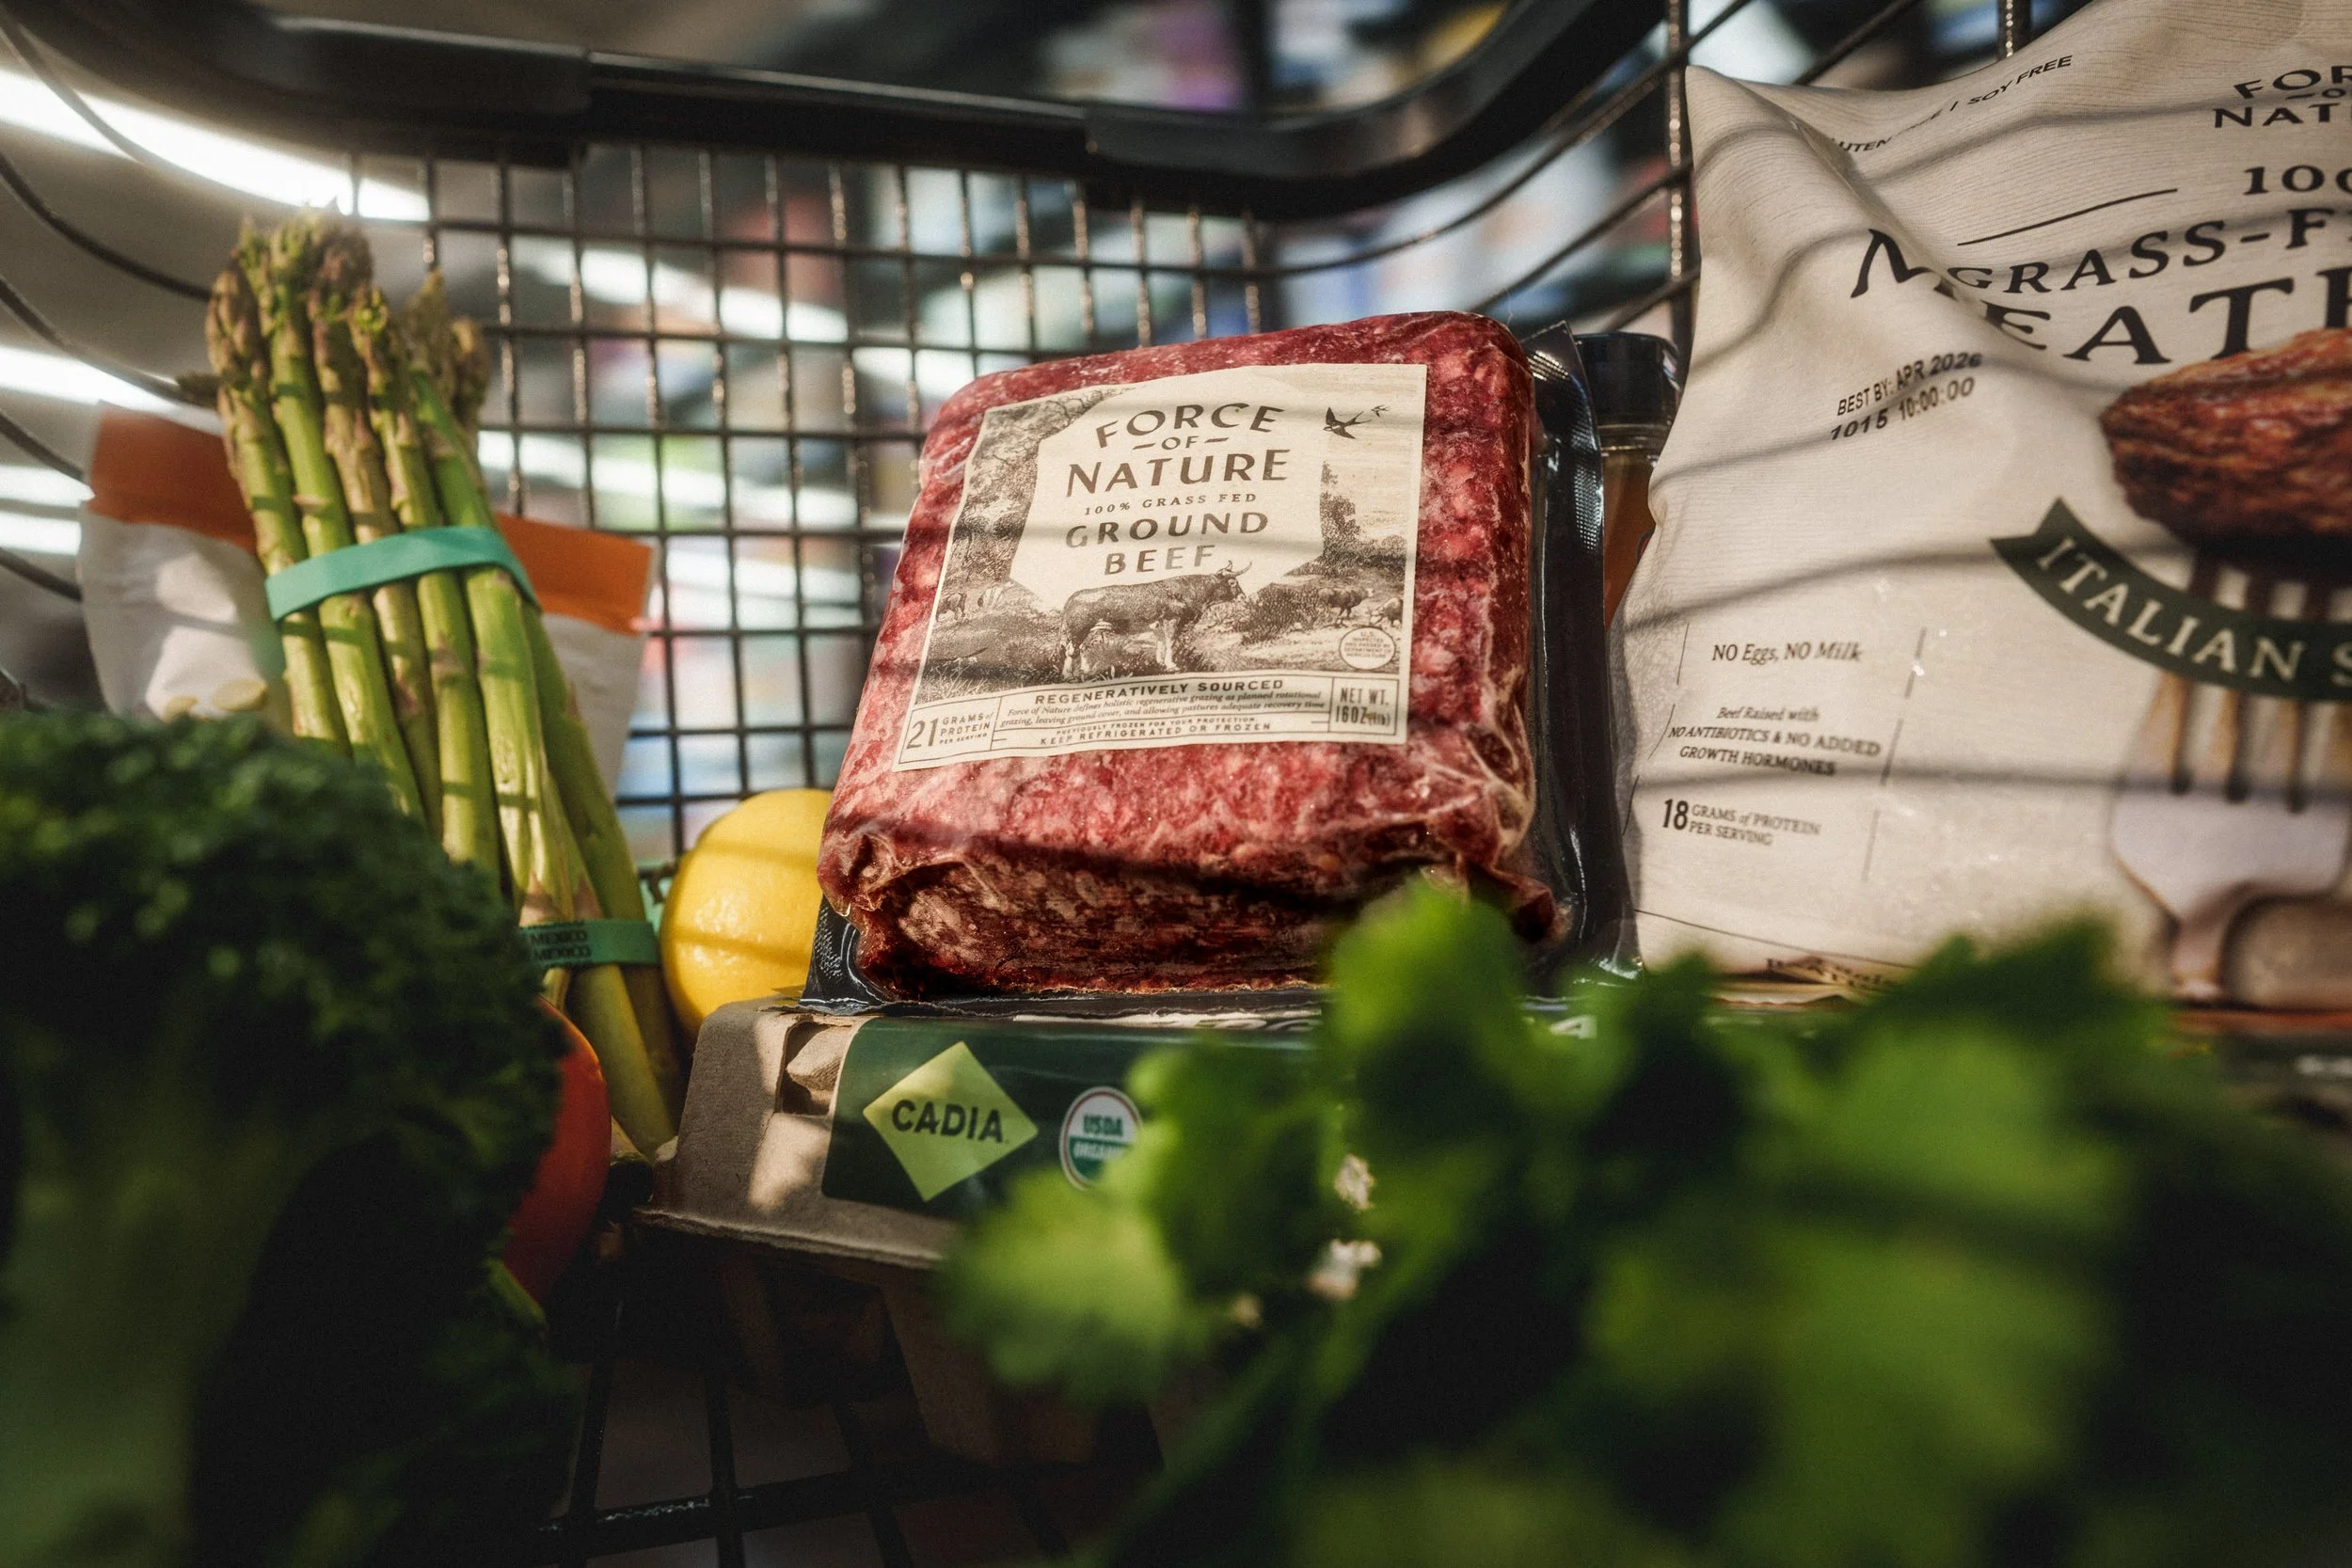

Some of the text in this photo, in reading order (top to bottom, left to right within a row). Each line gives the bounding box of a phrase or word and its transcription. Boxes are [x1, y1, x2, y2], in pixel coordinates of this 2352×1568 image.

[1966, 81, 2012, 105] SOY
[2015, 55, 2074, 85] FREE
[2213, 103, 2352, 128] NAT
[1947, 206, 2352, 294] GRASS-F
[1837, 352, 1983, 416] BEST BY: APR 2026
[1830, 376, 1976, 440] 1015 10:00:00
[1096, 403, 1284, 448] FORCE
[1161, 436, 1199, 451] OF
[1066, 449, 1291, 498] NATURE
[1085, 493, 1257, 515] 100% GRASS FED
[1066, 512, 1268, 548] GROUND
[1104, 545, 1216, 576] BEEF
[2037, 538, 2304, 682] ITALIAN
[1712, 641, 1863, 666] NO Eggs, NO Milk
[1008, 708, 1030, 717] Force
[1031, 706, 1040, 716] of
[1041, 705, 1071, 715] Nature
[1073, 702, 1102, 713] defines
[1104, 699, 1134, 708] holistic
[1136, 695, 1188, 707] regenerative
[1189, 693, 1223, 704] grazing
[1237, 691, 1275, 702] planned
[1276, 690, 1322, 700] rotational
[1035, 680, 1284, 705] REGENERATIVELY SOURCED
[1340, 688, 1390, 705] NET WT.
[941, 721, 991, 736] PROTEIN
[1000, 718, 1033, 728] grazing,
[1035, 716, 1066, 725] leaving
[1067, 712, 1096, 723] ground
[1143, 705, 1180, 716] allowing
[1182, 705, 1218, 714] pastures
[1220, 701, 1262, 712] adequate
[1263, 701, 1303, 710] recovery
[1304, 700, 1326, 708] time
[1716, 706, 1820, 722] Beef Raised with
[906, 718, 939, 750] 21
[942, 713, 984, 725] GRAMS
[1041, 735, 1073, 745] KEEP
[1079, 727, 1182, 741] REFRIGERATED
[1216, 722, 1270, 732] FROZEN
[1668, 726, 1687, 738] NO
[1687, 726, 1771, 743] ANTIBIOTICS
[1786, 732, 1811, 748] NO
[1813, 735, 1881, 757] ADDED
[1679, 745, 1836, 777] GROWTH HORMONES
[1662, 799, 1689, 831] 18
[1692, 803, 1737, 822] GRAMS
[1753, 813, 1823, 836] PROTEIN
[1689, 820, 1774, 847] PER SERVING
[891, 1099, 1003, 1143] CADIA
